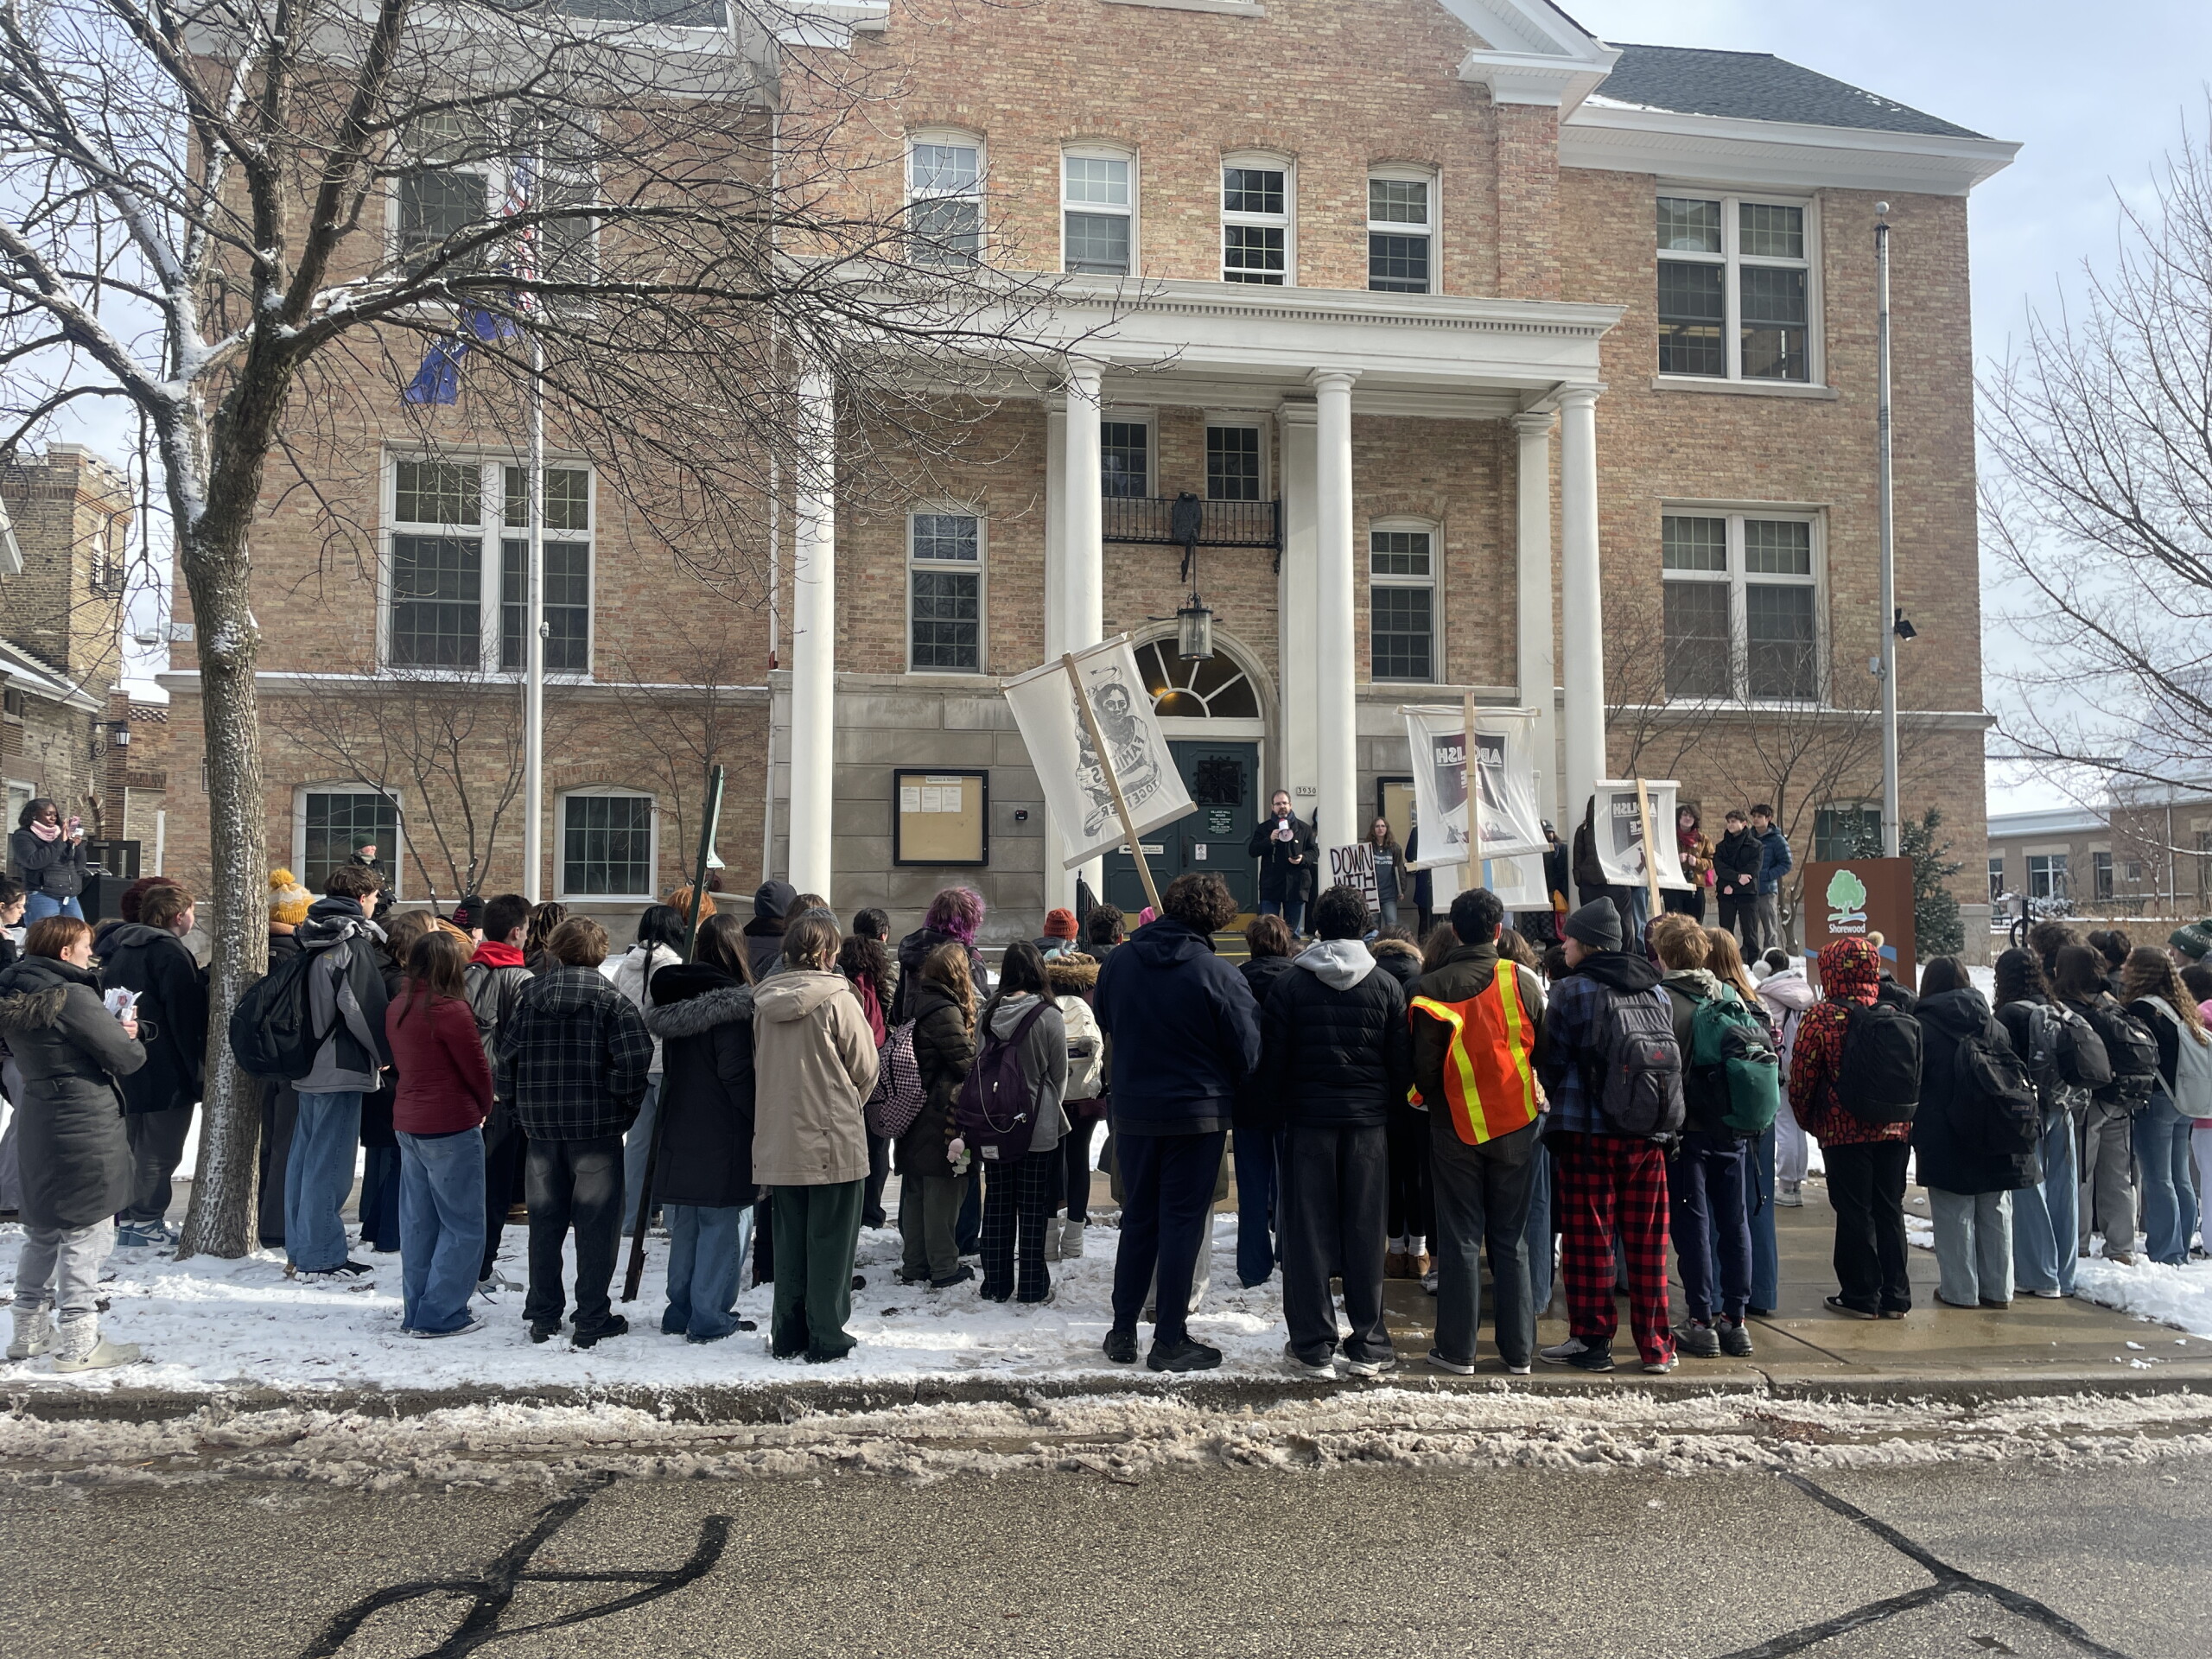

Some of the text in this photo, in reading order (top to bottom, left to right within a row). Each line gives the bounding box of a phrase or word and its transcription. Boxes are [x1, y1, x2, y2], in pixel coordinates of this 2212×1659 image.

[1330, 843, 1374, 875] DOWN
[1334, 872, 1376, 887] WITH
[1829, 924, 1866, 933] Shorewood
